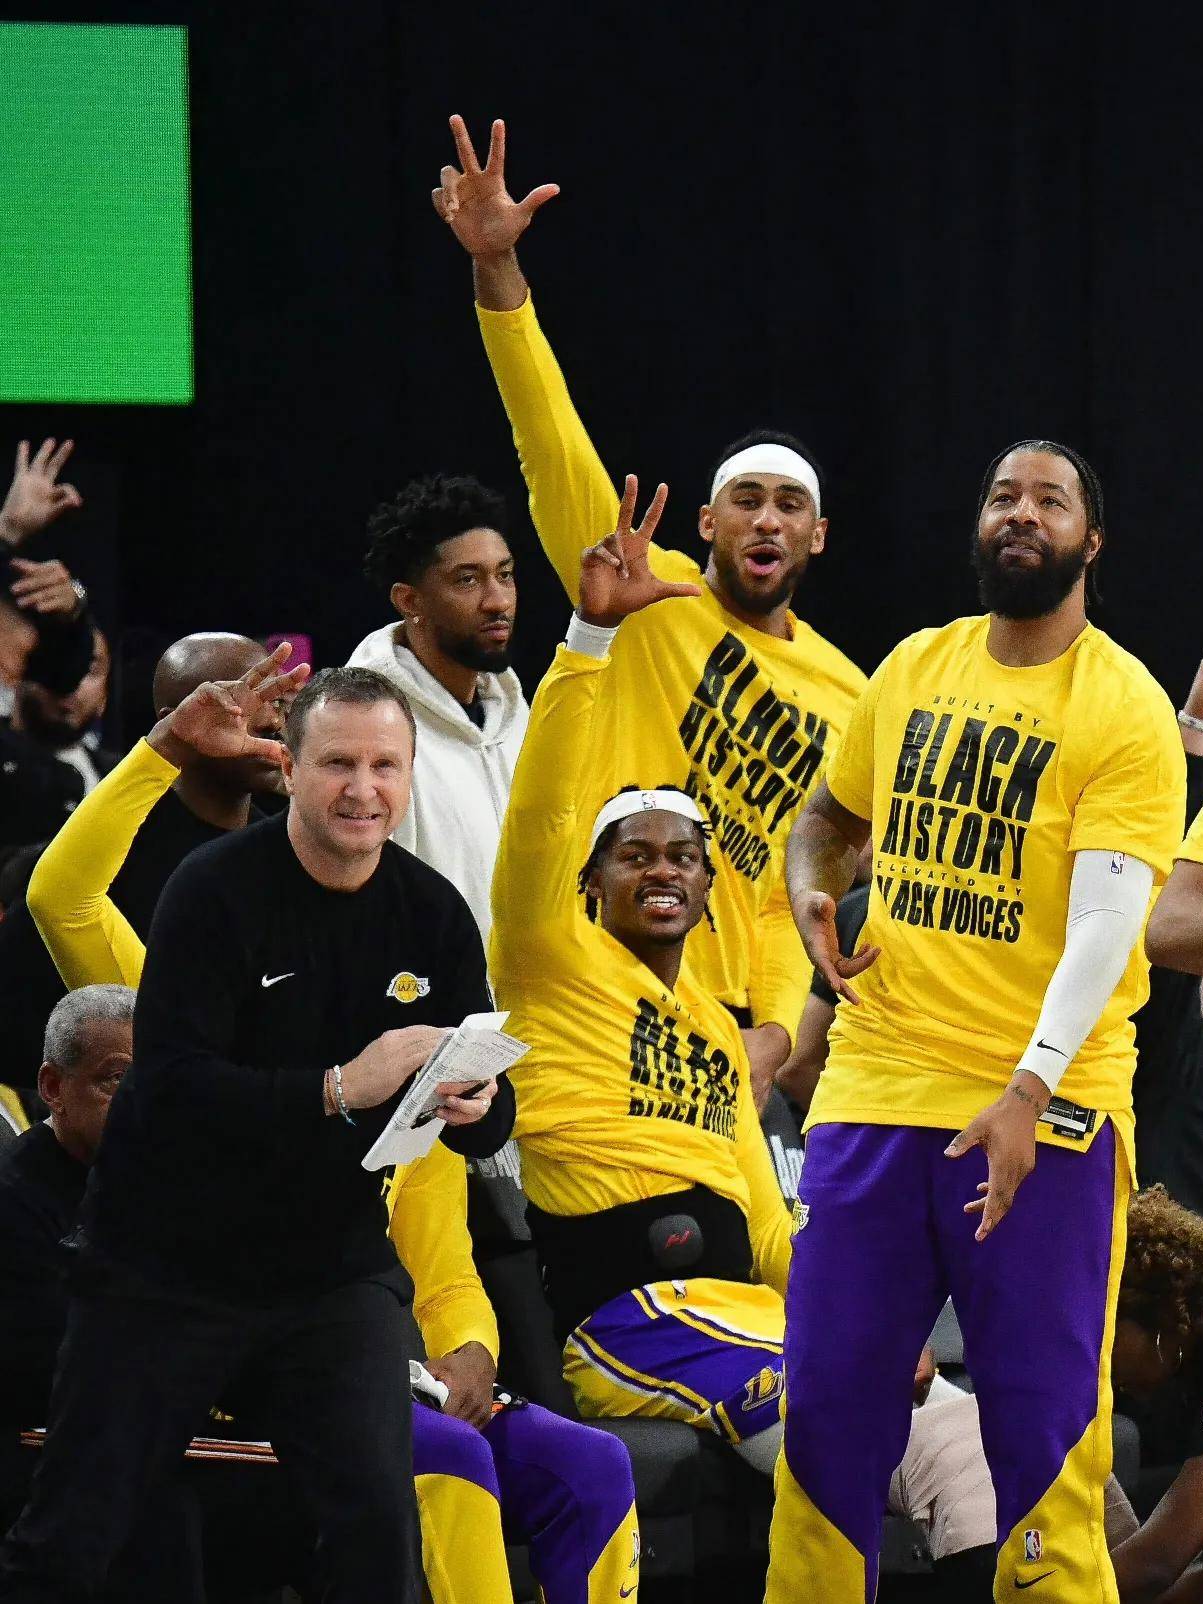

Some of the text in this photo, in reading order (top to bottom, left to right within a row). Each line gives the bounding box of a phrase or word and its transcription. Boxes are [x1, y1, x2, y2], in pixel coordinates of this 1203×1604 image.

[933, 695, 1042, 728] BUILT BY
[892, 708, 1057, 823] BLACK
[880, 796, 1028, 880] HISTORY
[938, 886, 1025, 944] VOICES
